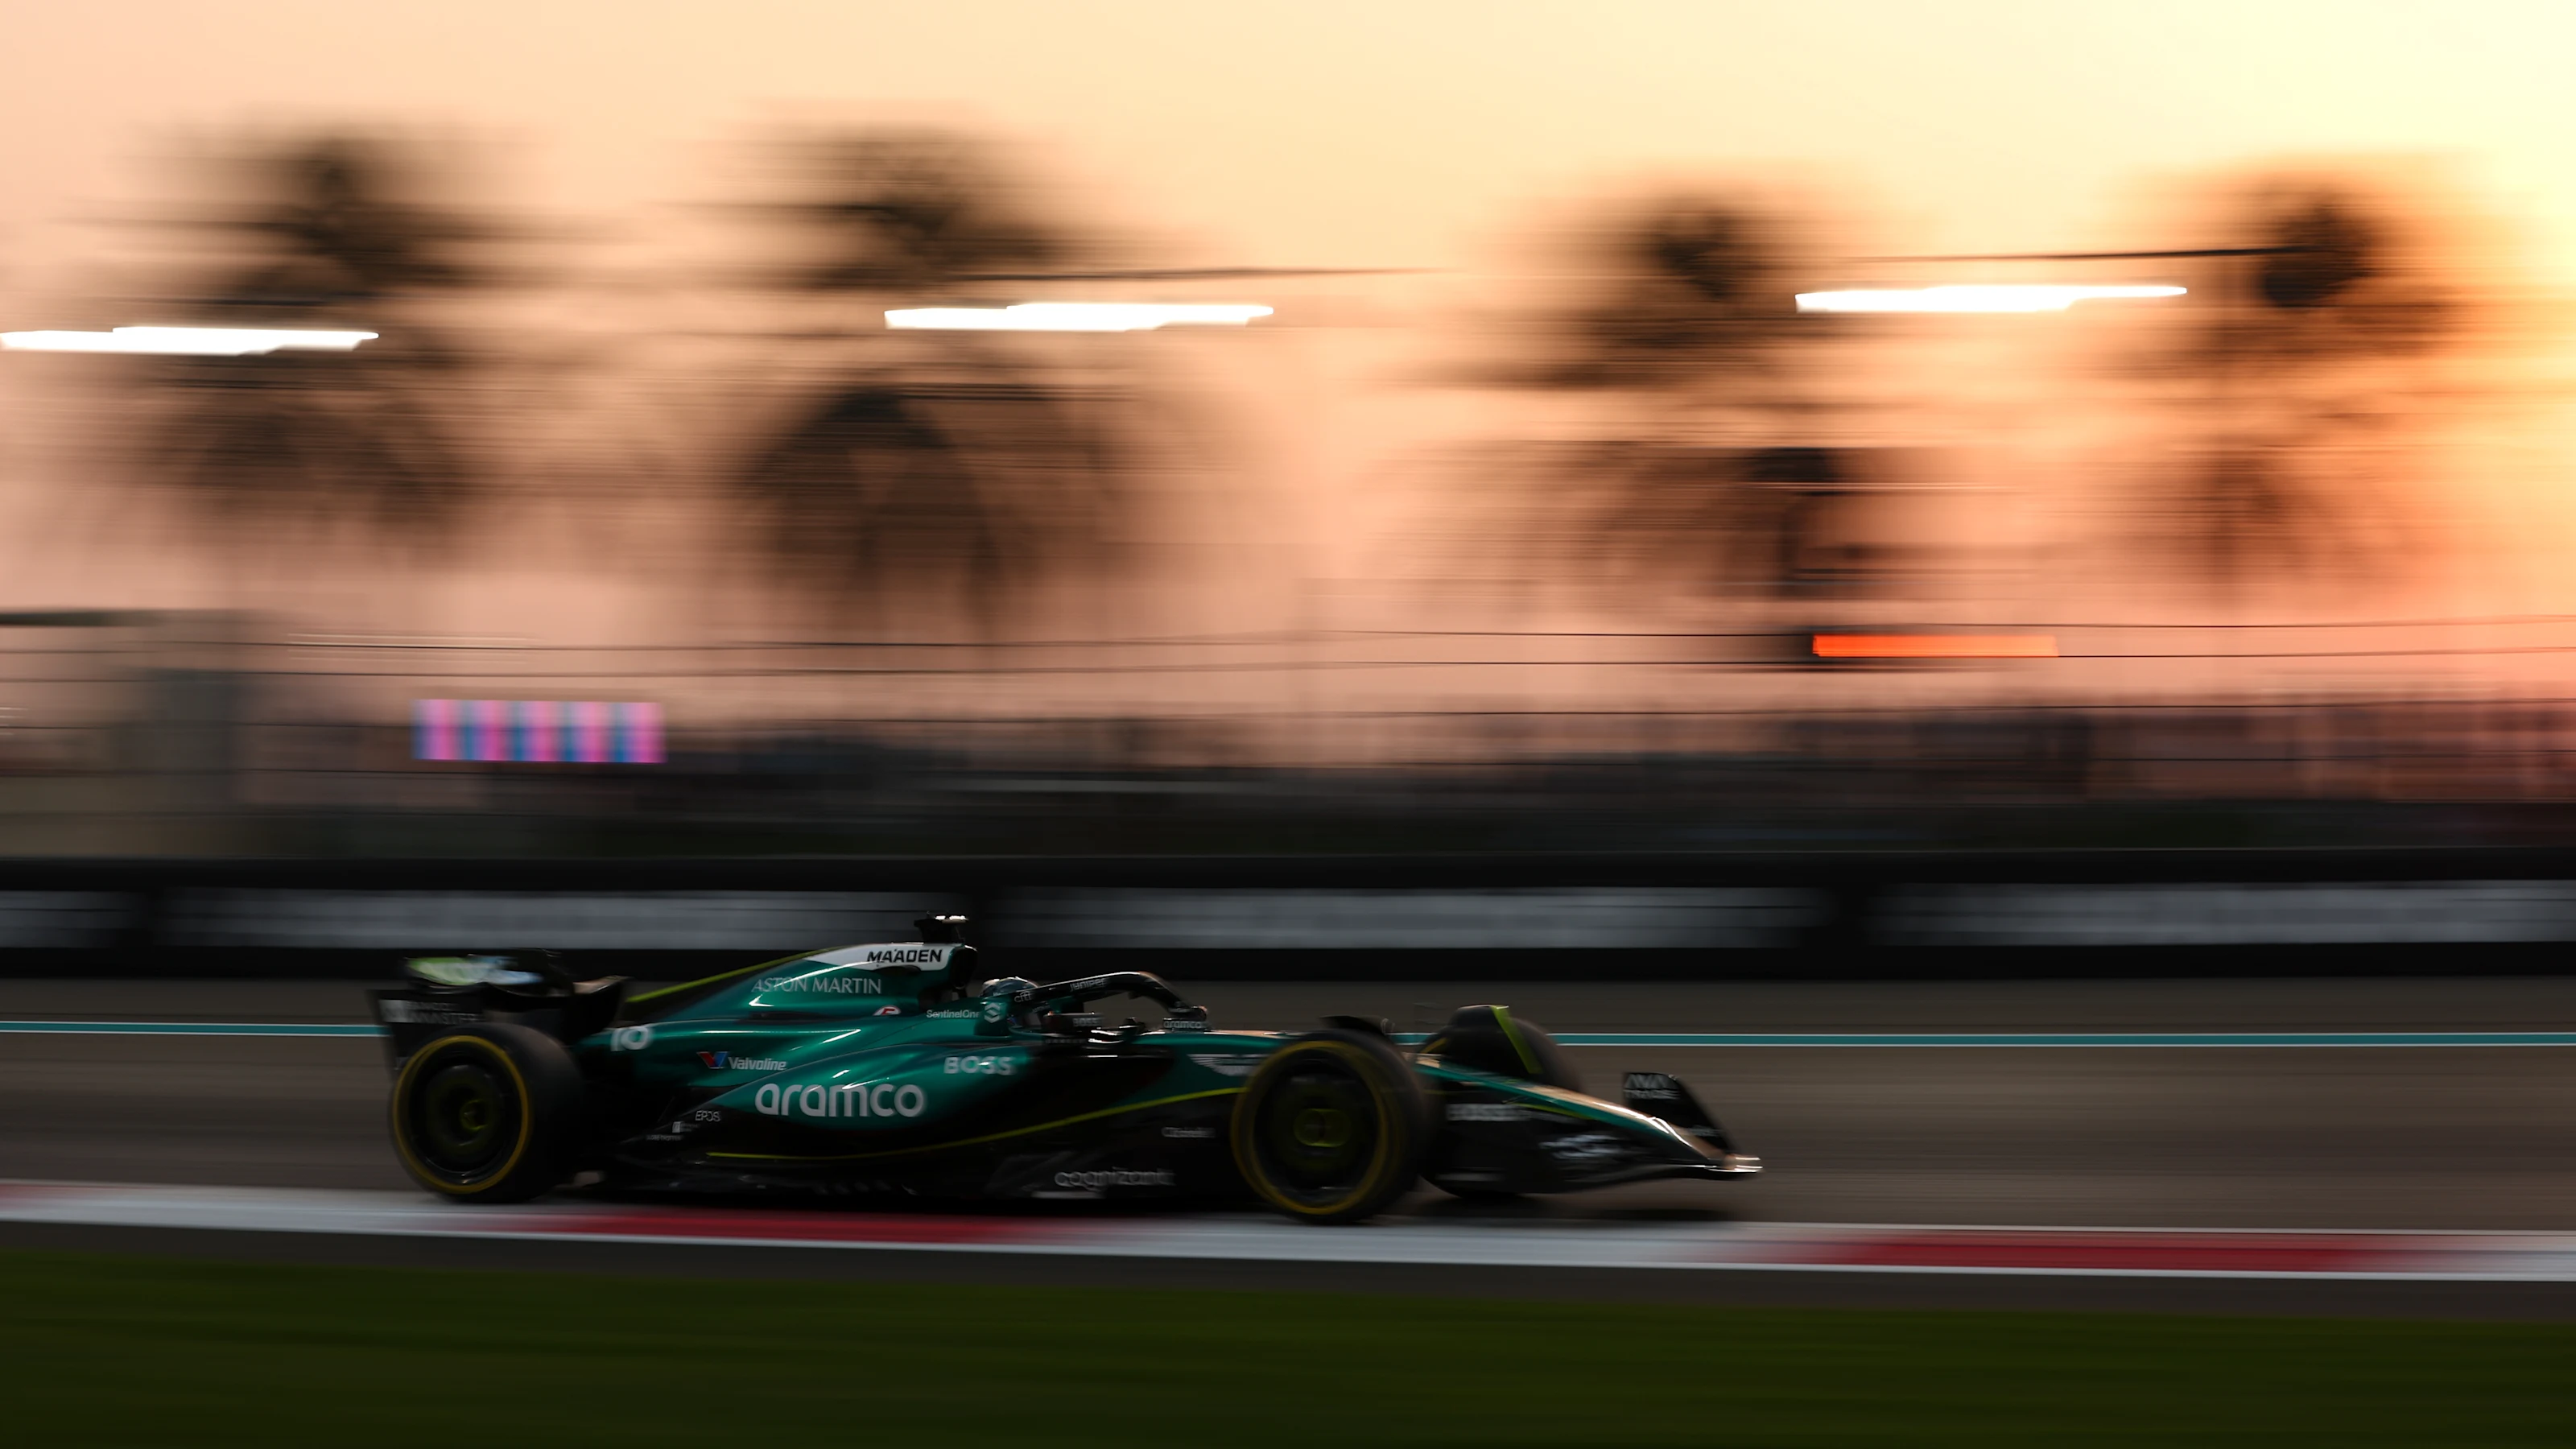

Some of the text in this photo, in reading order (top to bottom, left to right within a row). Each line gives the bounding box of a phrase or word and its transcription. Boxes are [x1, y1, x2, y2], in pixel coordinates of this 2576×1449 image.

[750, 976, 882, 995] ASTON MARTIN
[925, 1009, 980, 1019] SentinelOne
[727, 1056, 786, 1071] Valvoline
[943, 1055, 1018, 1075] BOSS
[753, 1083, 927, 1118] aramco
[695, 1109, 721, 1122] EPOS
